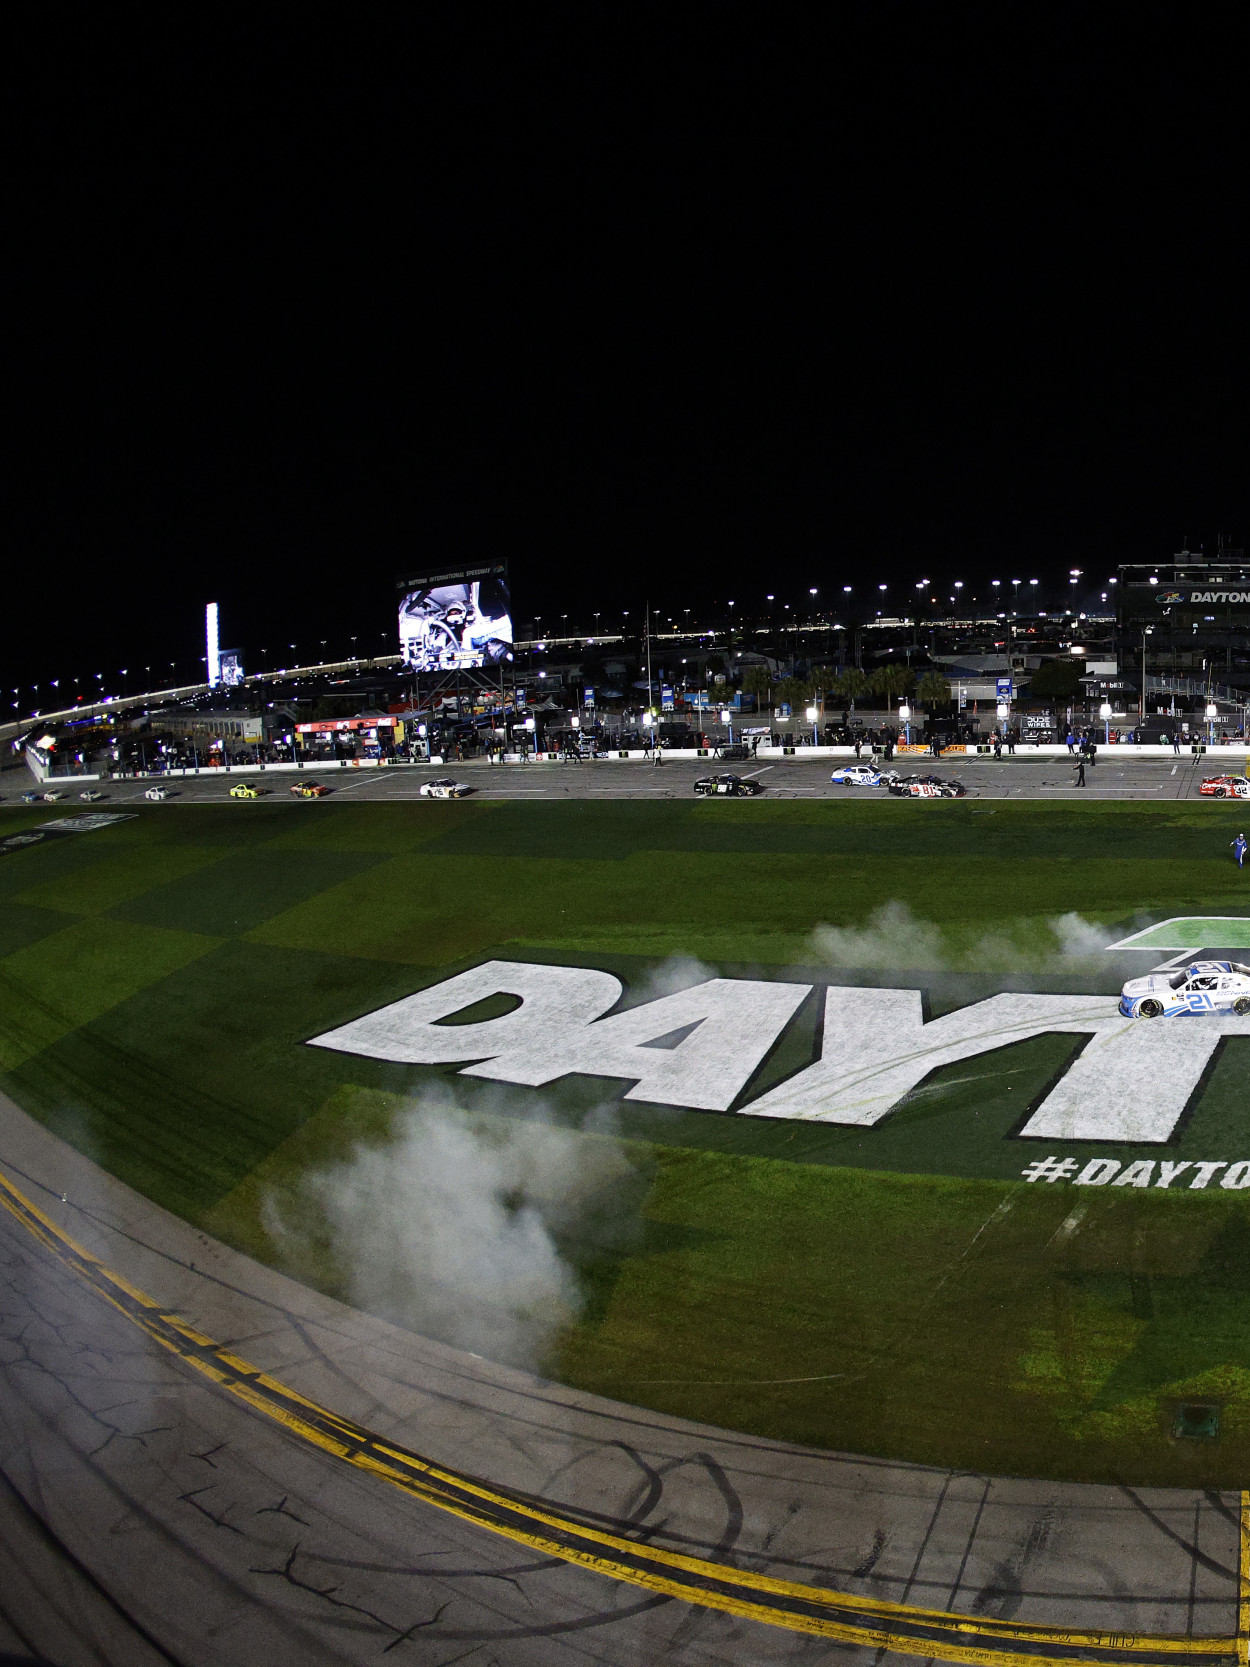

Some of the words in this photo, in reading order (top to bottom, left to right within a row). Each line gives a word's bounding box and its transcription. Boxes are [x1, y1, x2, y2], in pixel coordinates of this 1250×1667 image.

[860, 775, 872, 783] 20
[922, 785, 934, 795] 81
[1235, 786, 1248, 795] 32
[1186, 994, 1216, 1011] 21
